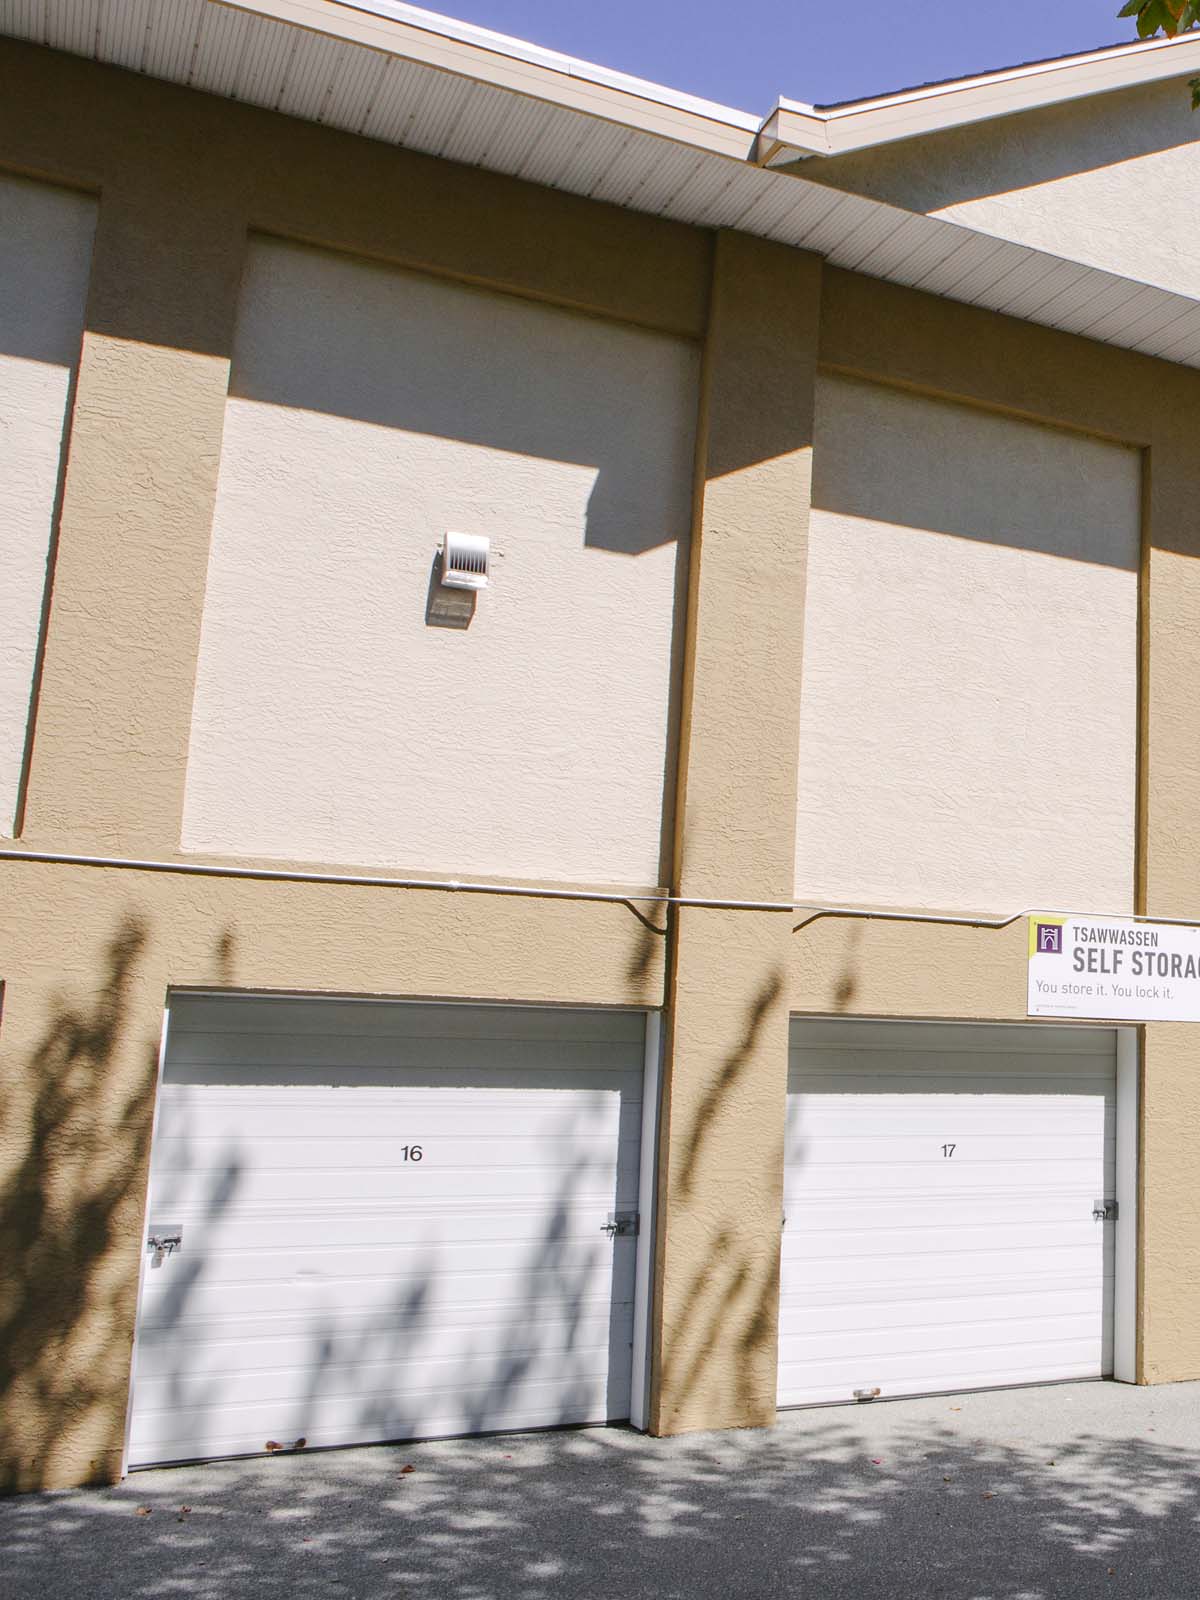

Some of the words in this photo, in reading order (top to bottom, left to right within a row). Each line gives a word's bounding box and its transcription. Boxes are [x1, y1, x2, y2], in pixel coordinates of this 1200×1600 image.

[1073, 926, 1159, 947] TSAWWASSEN
[1073, 947, 1123, 974] SELF
[1036, 979, 1057, 993] You
[1060, 981, 1093, 995] store
[1096, 983, 1108, 996] it.
[1111, 984, 1132, 997] You
[1135, 985, 1160, 999] lock
[1163, 986, 1174, 1000] it.
[401, 1145, 423, 1162] 16
[941, 1144, 957, 1158] 17
